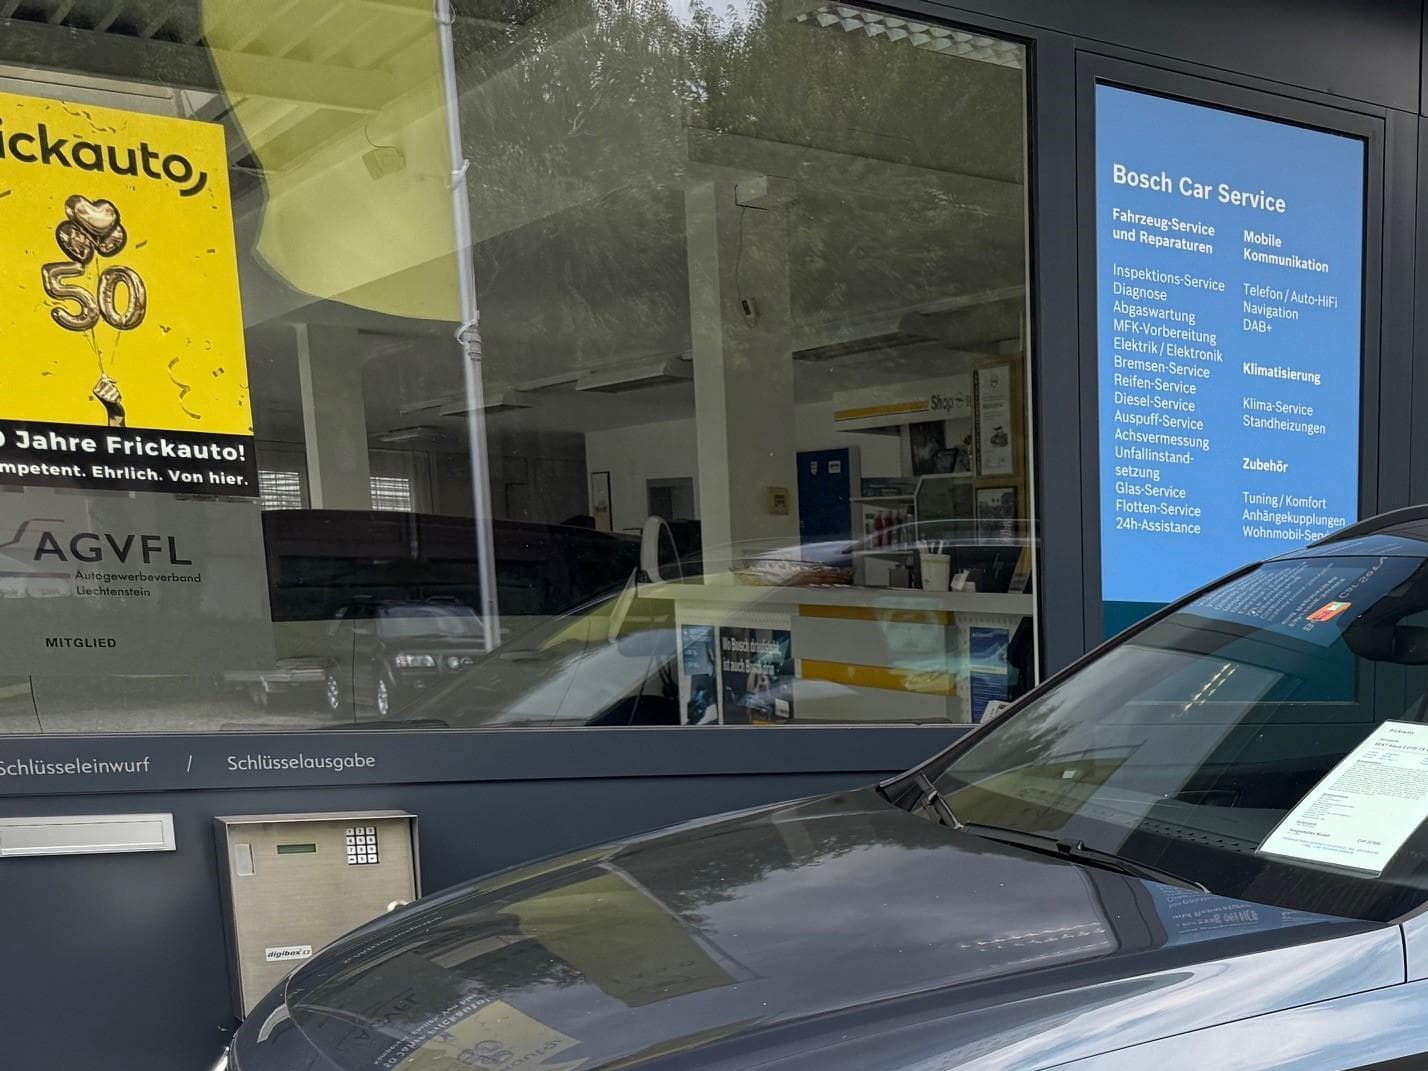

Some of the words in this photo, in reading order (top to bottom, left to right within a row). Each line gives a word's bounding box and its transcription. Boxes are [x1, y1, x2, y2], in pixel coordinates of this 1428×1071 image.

[1113, 164, 1172, 193] Bosch
[1179, 176, 1212, 200] Car
[1218, 184, 1286, 213] Service
[1113, 208, 1215, 236] Fahrzeug-Service
[1113, 228, 1135, 242] und
[1140, 231, 1213, 254] Reparaturen
[1243, 230, 1282, 248] Mobile
[1243, 248, 1329, 273] Kommunikation
[1113, 264, 1225, 292] Inspektions-Service
[1113, 282, 1167, 302] Diagnose
[1243, 283, 1283, 301] Telefon
[1291, 290, 1338, 309] Auto-HiFi
[1113, 300, 1196, 326] Abgaswartung
[1243, 301, 1299, 321] Navigation
[1113, 319, 1217, 347] MFK-Vorbereitung
[1243, 318, 1272, 333] DAB+
[1113, 337, 1158, 355] Elektrik
[1166, 343, 1223, 363] Elektronik
[1113, 355, 1210, 379] Bremsen-Service
[1243, 362, 1321, 386] Klimatisierung
[1114, 373, 1196, 395] Reifen-Service
[1114, 391, 1196, 412] Diesel-Service
[1243, 397, 1313, 417] Klima-Service
[1114, 409, 1204, 430] Auspuff-Service
[1243, 415, 1326, 435] Standheizungen
[15, 430, 97, 453] Jahre
[106, 436, 246, 462] Frickauto!
[1114, 428, 1210, 450] Achsvermessung
[1115, 446, 1194, 464] Unfallinstand-
[1243, 457, 1288, 473] Zubehör
[93, 466, 163, 481] Ehrlich.
[168, 470, 203, 483] Von
[209, 471, 249, 486] hier.
[1115, 464, 1160, 481] setzung
[1115, 482, 1186, 499] Glas-Service
[1243, 491, 1278, 508] Tuning
[1286, 495, 1327, 509] Komfort
[1116, 500, 1201, 518] Flotten-Service
[1243, 509, 1345, 528] Anhängekupplungen
[1116, 517, 1201, 534] 24h-Assistance
[33, 531, 193, 566] AGVFL
[75, 570, 201, 584] Autogewerbeverband
[76, 586, 152, 597] Liechtenstein
[45, 637, 117, 649] MITGLIED
[0, 756, 151, 776] Schlüsseleinwurf
[227, 753, 376, 772] Schlüsselausgabe
